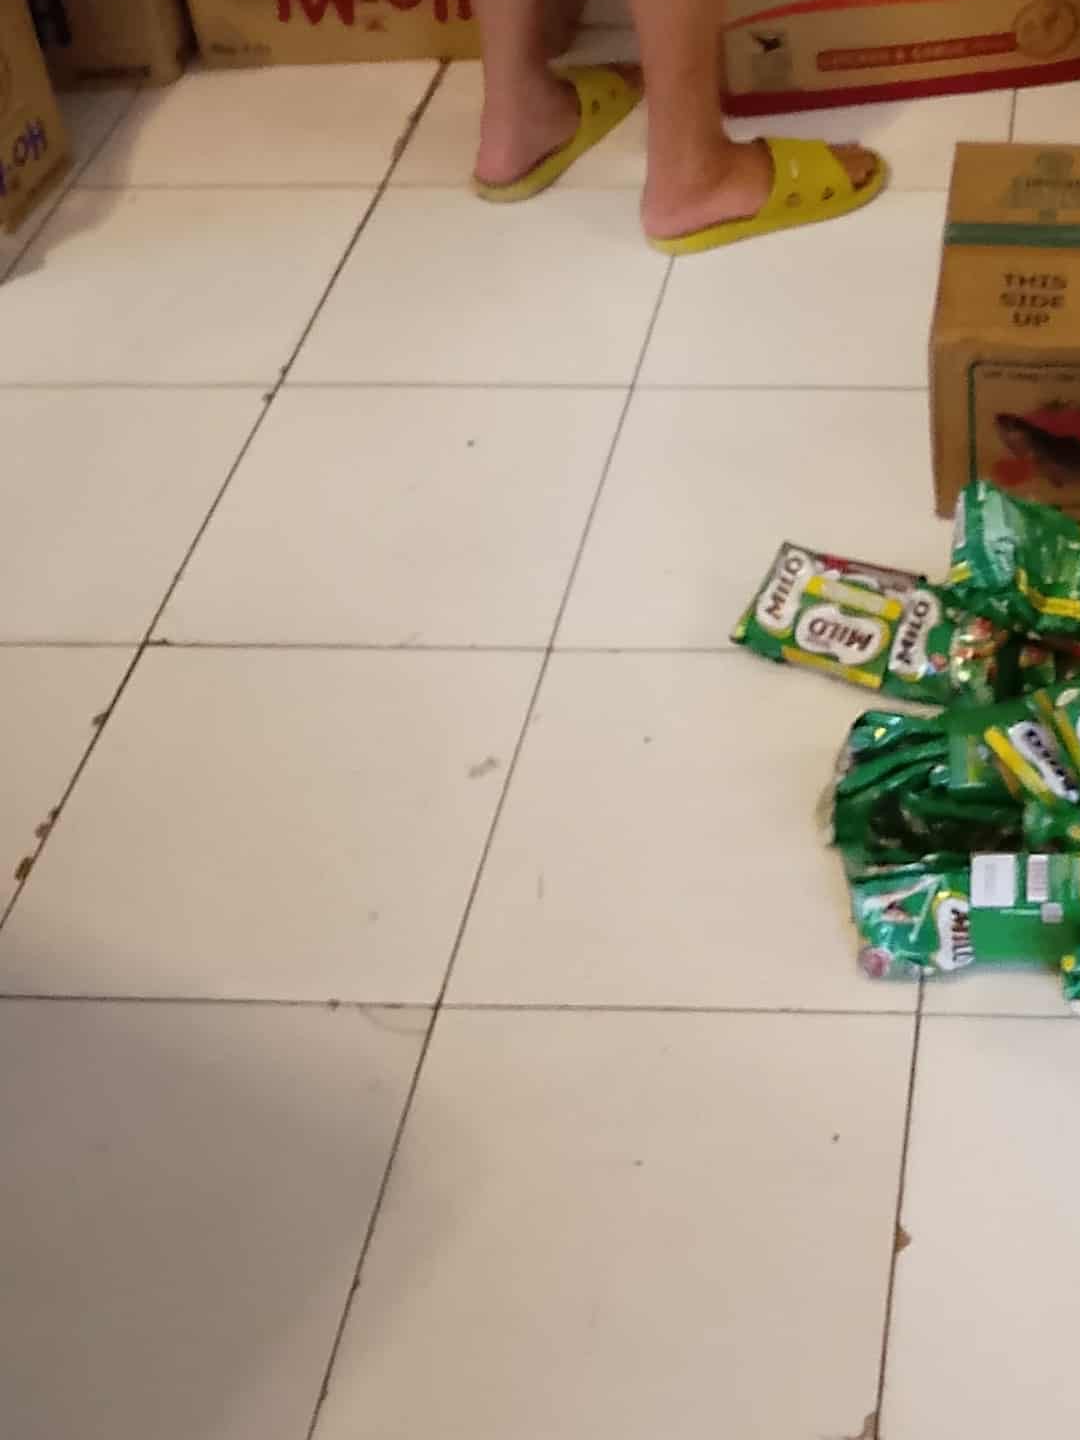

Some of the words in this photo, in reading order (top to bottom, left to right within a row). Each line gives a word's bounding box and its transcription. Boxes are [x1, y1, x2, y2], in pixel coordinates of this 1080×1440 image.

[1002, 272, 1067, 289] THIS
[1012, 311, 1050, 327] UP
[765, 556, 804, 621] MILO
[807, 616, 874, 652] MILO
[898, 598, 931, 666] MILO
[952, 907, 975, 961] MIL
